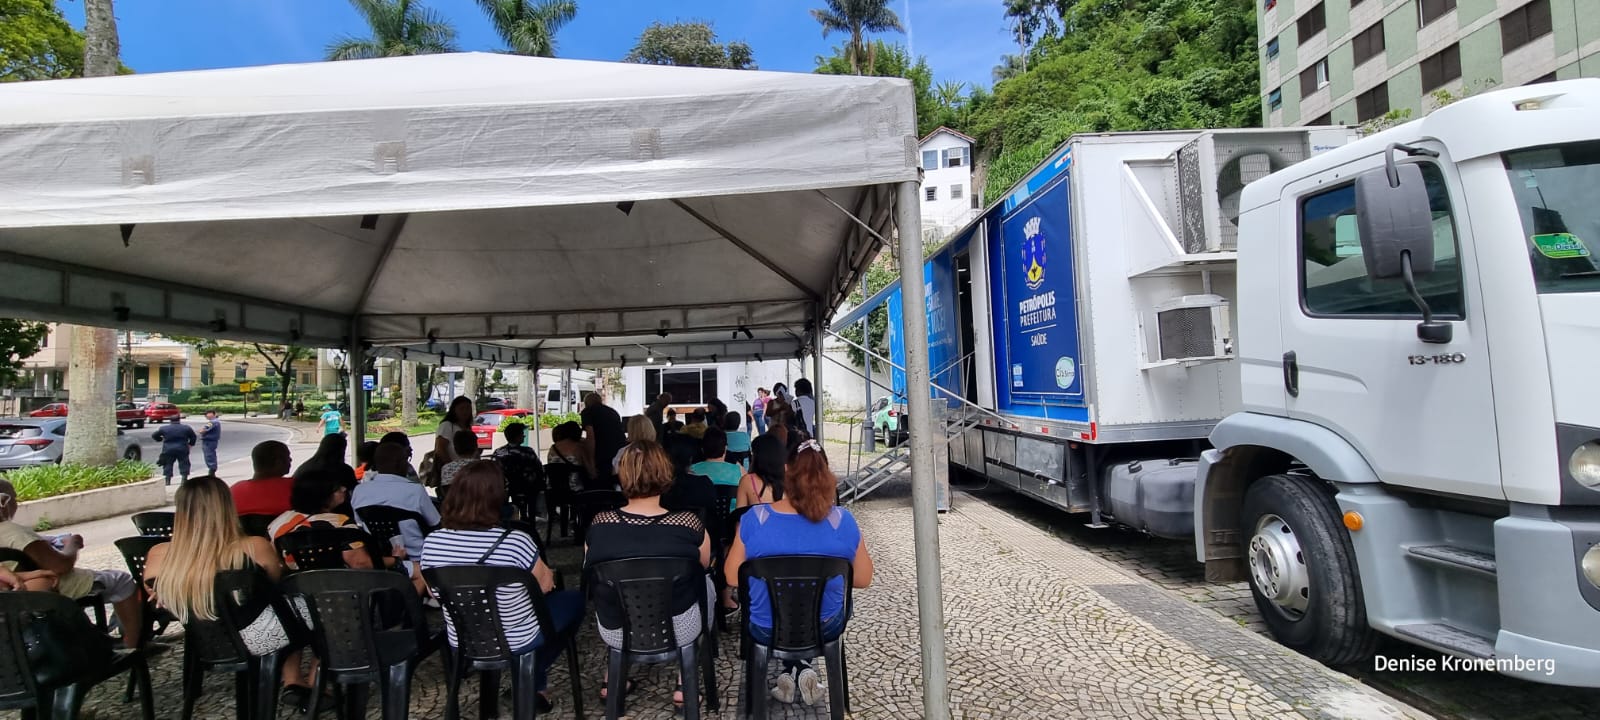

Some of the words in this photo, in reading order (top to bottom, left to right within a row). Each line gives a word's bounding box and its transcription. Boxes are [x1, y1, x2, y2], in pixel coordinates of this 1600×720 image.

[1019, 290, 1056, 315] PETRÓPOLIS
[1020, 307, 1057, 328] PREFEITURA
[1030, 332, 1047, 347] SAÚDE
[1407, 353, 1466, 365] 13-180
